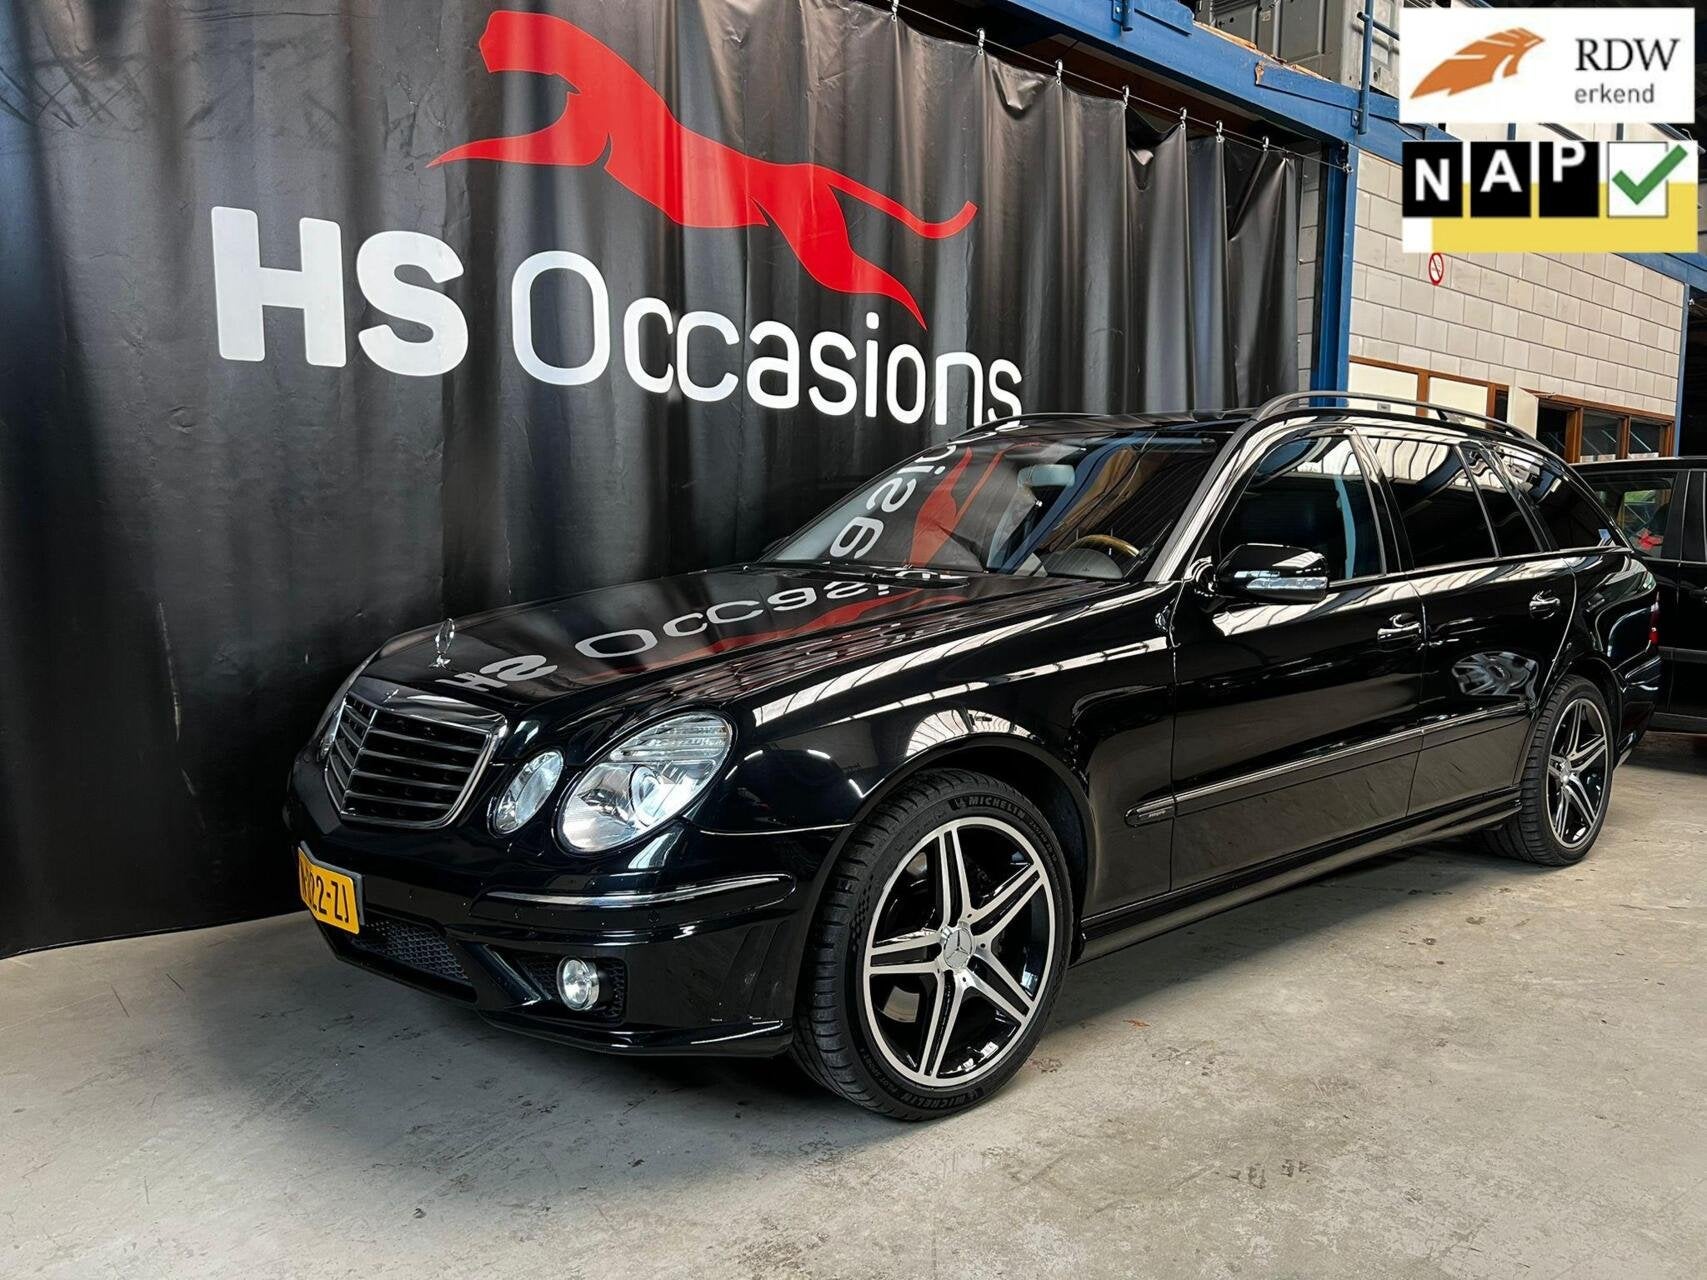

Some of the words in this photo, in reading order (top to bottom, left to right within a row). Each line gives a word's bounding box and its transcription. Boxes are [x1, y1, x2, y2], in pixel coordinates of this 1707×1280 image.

[210, 205, 468, 377] HS
[510, 250, 1023, 424] Occasions
[968, 795, 1026, 819] MICHELIN
